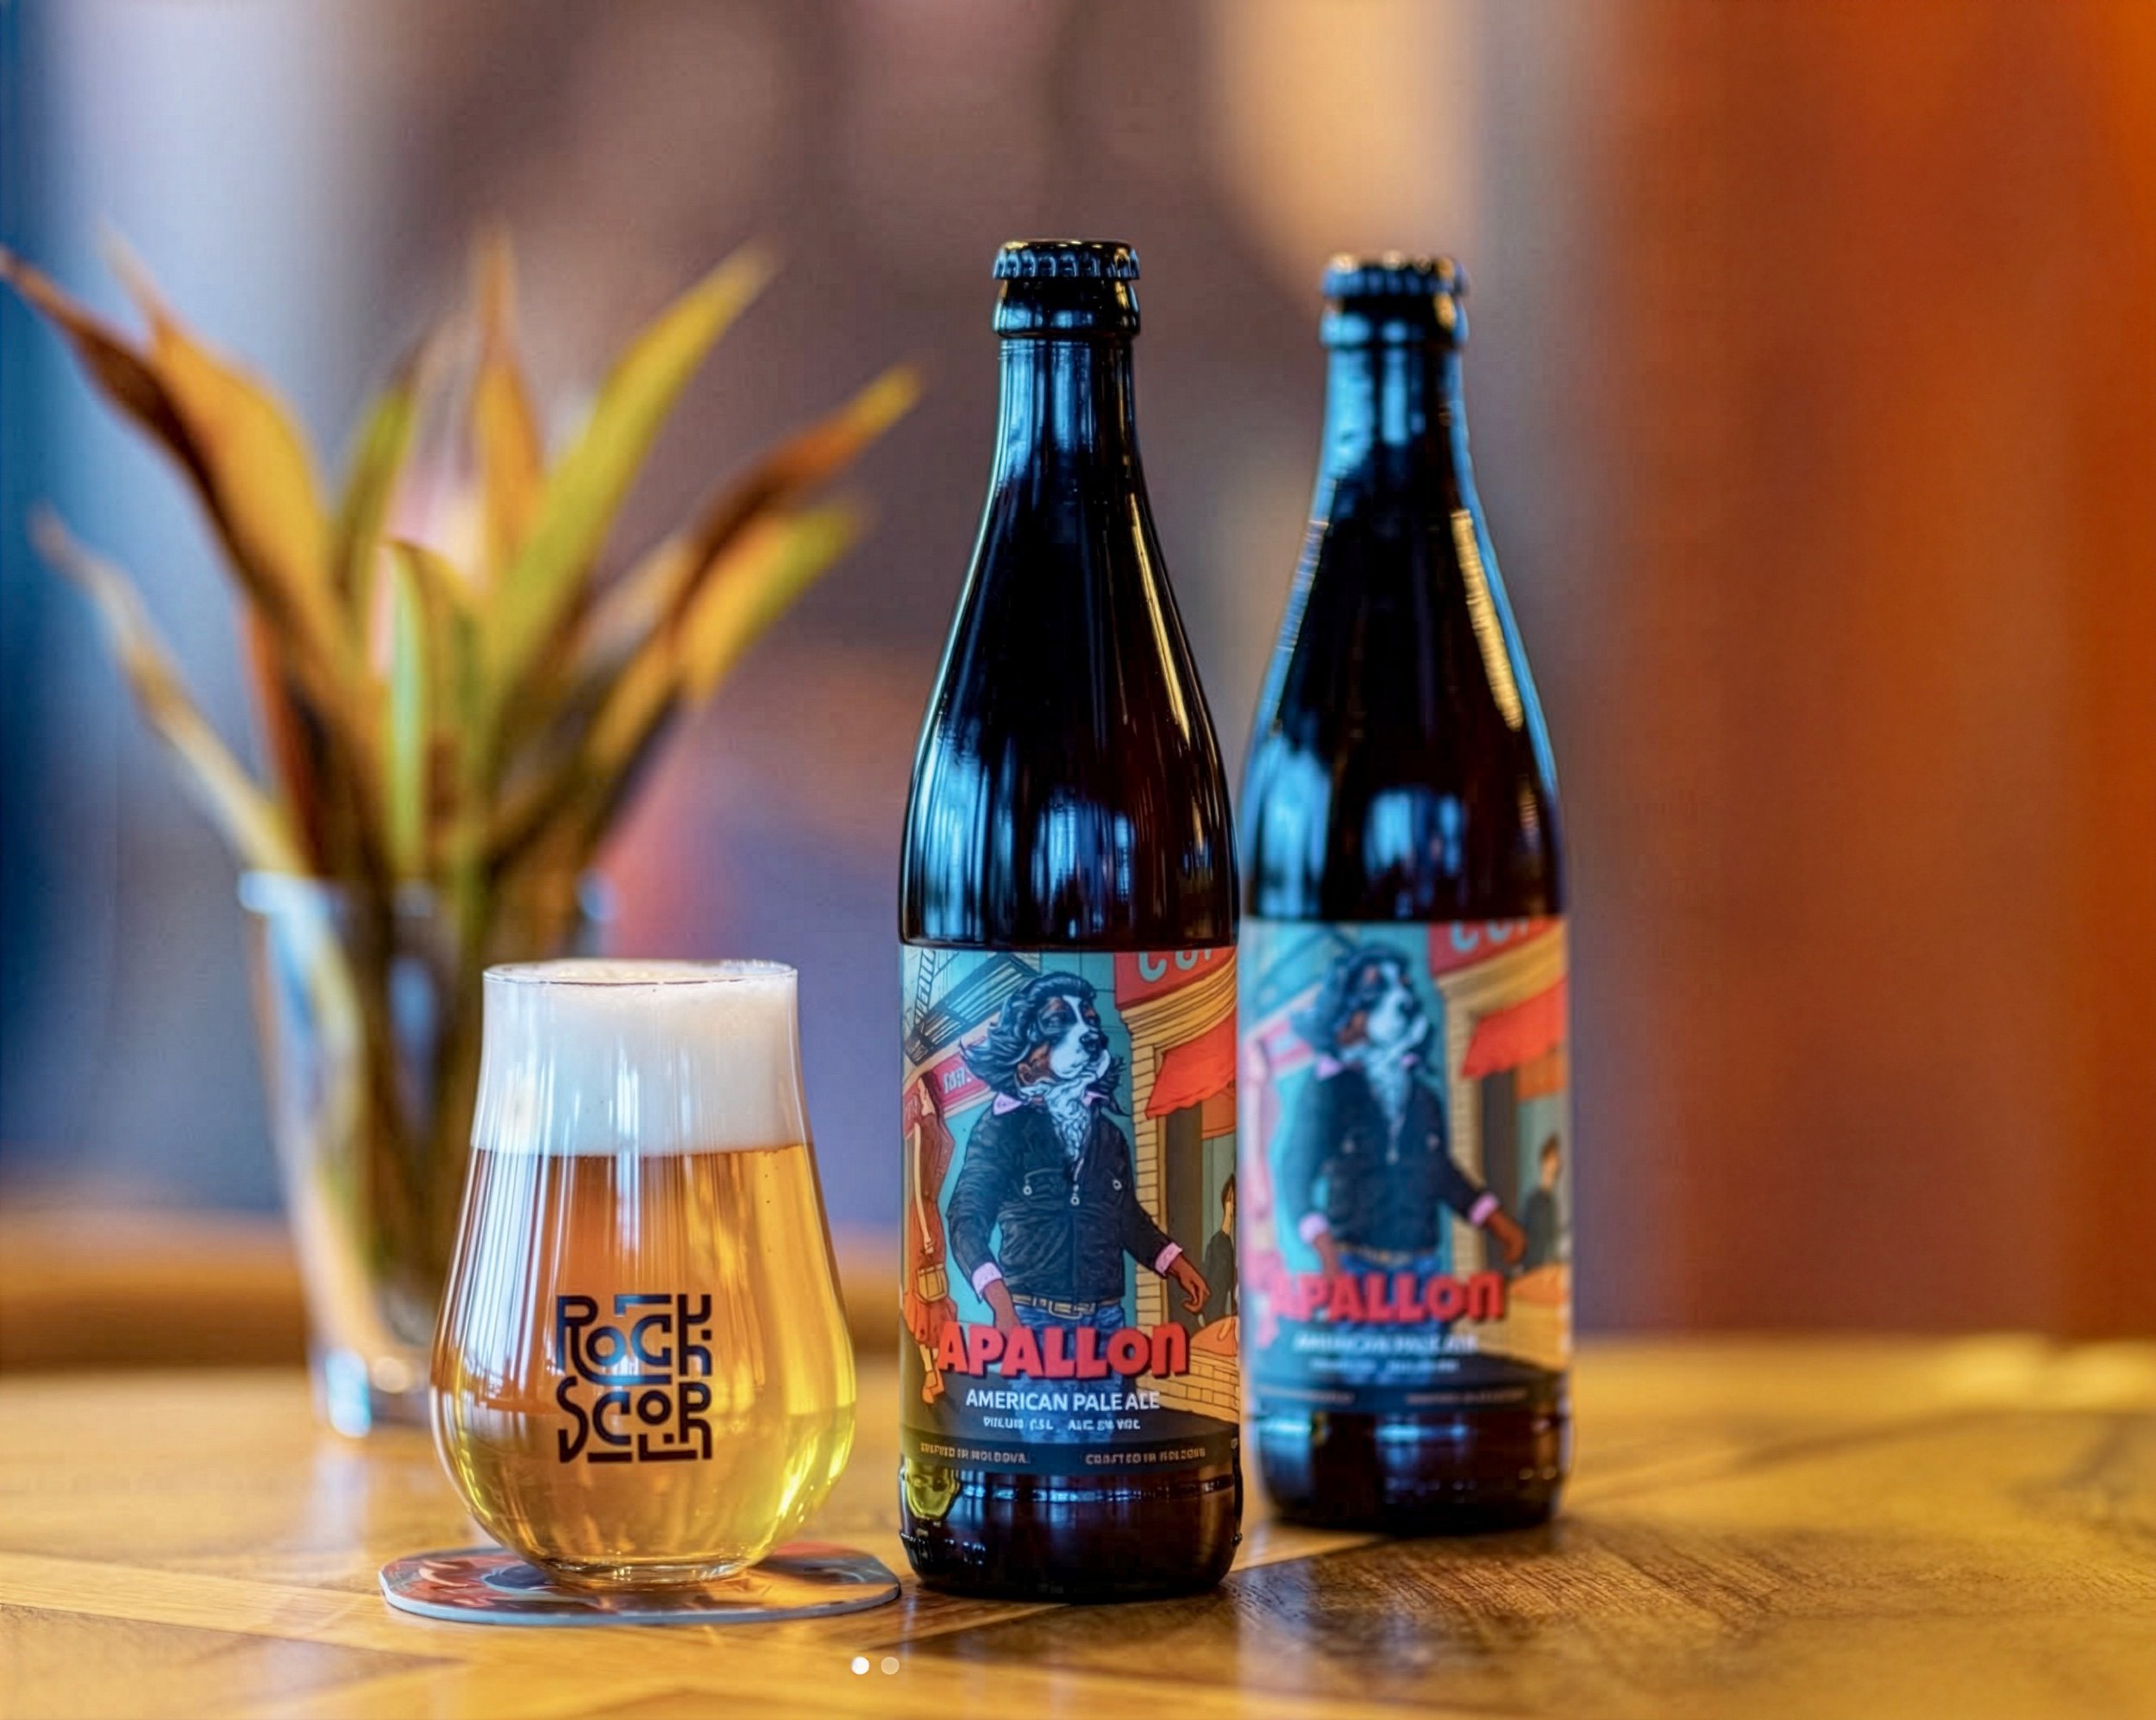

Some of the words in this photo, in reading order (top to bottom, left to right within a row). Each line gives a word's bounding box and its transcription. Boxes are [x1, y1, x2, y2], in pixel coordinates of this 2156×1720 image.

[937, 1321, 1190, 1378] APALLON
[965, 1388, 1069, 1411] AMERICAN
[1073, 1391, 1123, 1412] PALE
[1125, 1391, 1161, 1411] ALE
